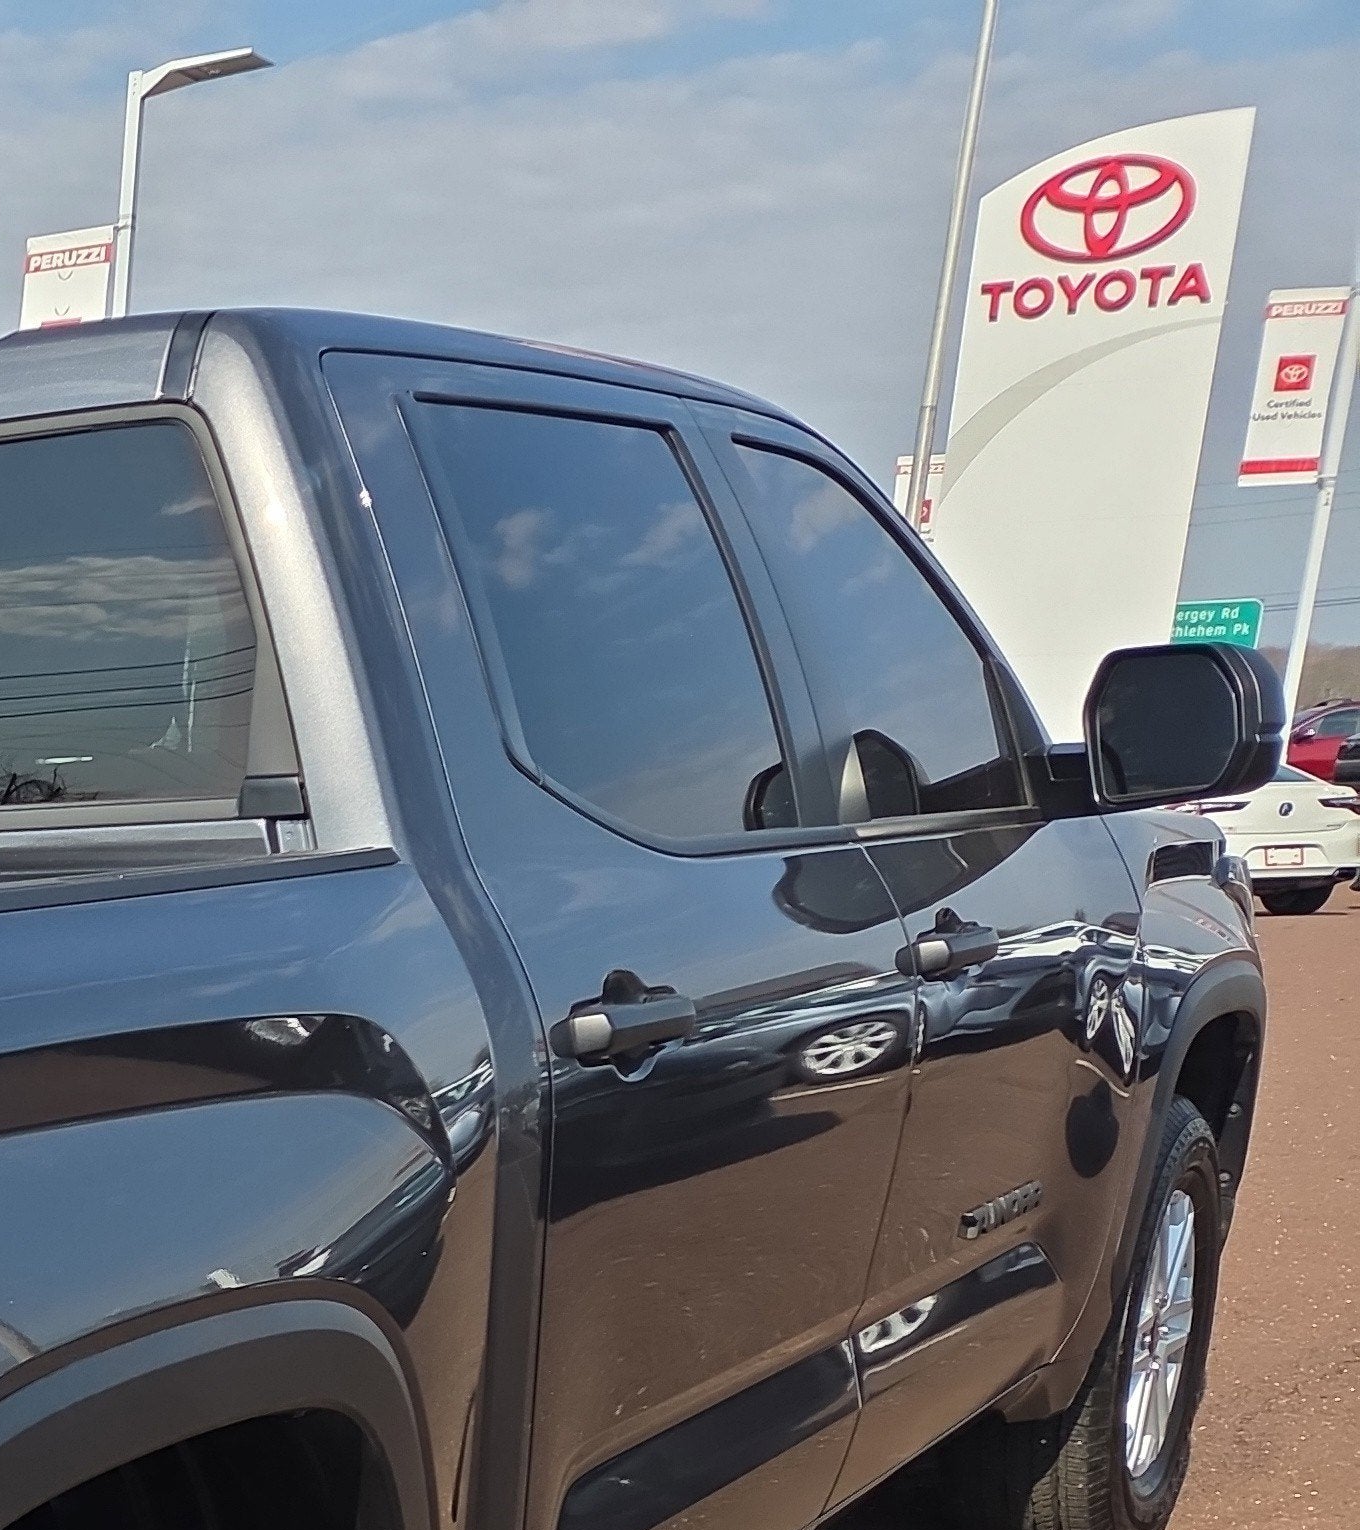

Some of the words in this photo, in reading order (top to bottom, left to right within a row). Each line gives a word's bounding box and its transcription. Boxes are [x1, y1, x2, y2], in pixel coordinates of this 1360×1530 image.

[29, 246, 106, 272] PERUZZI
[980, 263, 1212, 323] TOYOTA
[1270, 301, 1345, 317] PERUZZI
[1266, 398, 1313, 409] Certified
[1252, 411, 1279, 421] Used
[1280, 410, 1323, 420] Vehicles
[1175, 610, 1216, 624] ergey
[1221, 606, 1240, 620] Rd
[1171, 624, 1227, 637] hlehem
[1232, 622, 1250, 636] Pk
